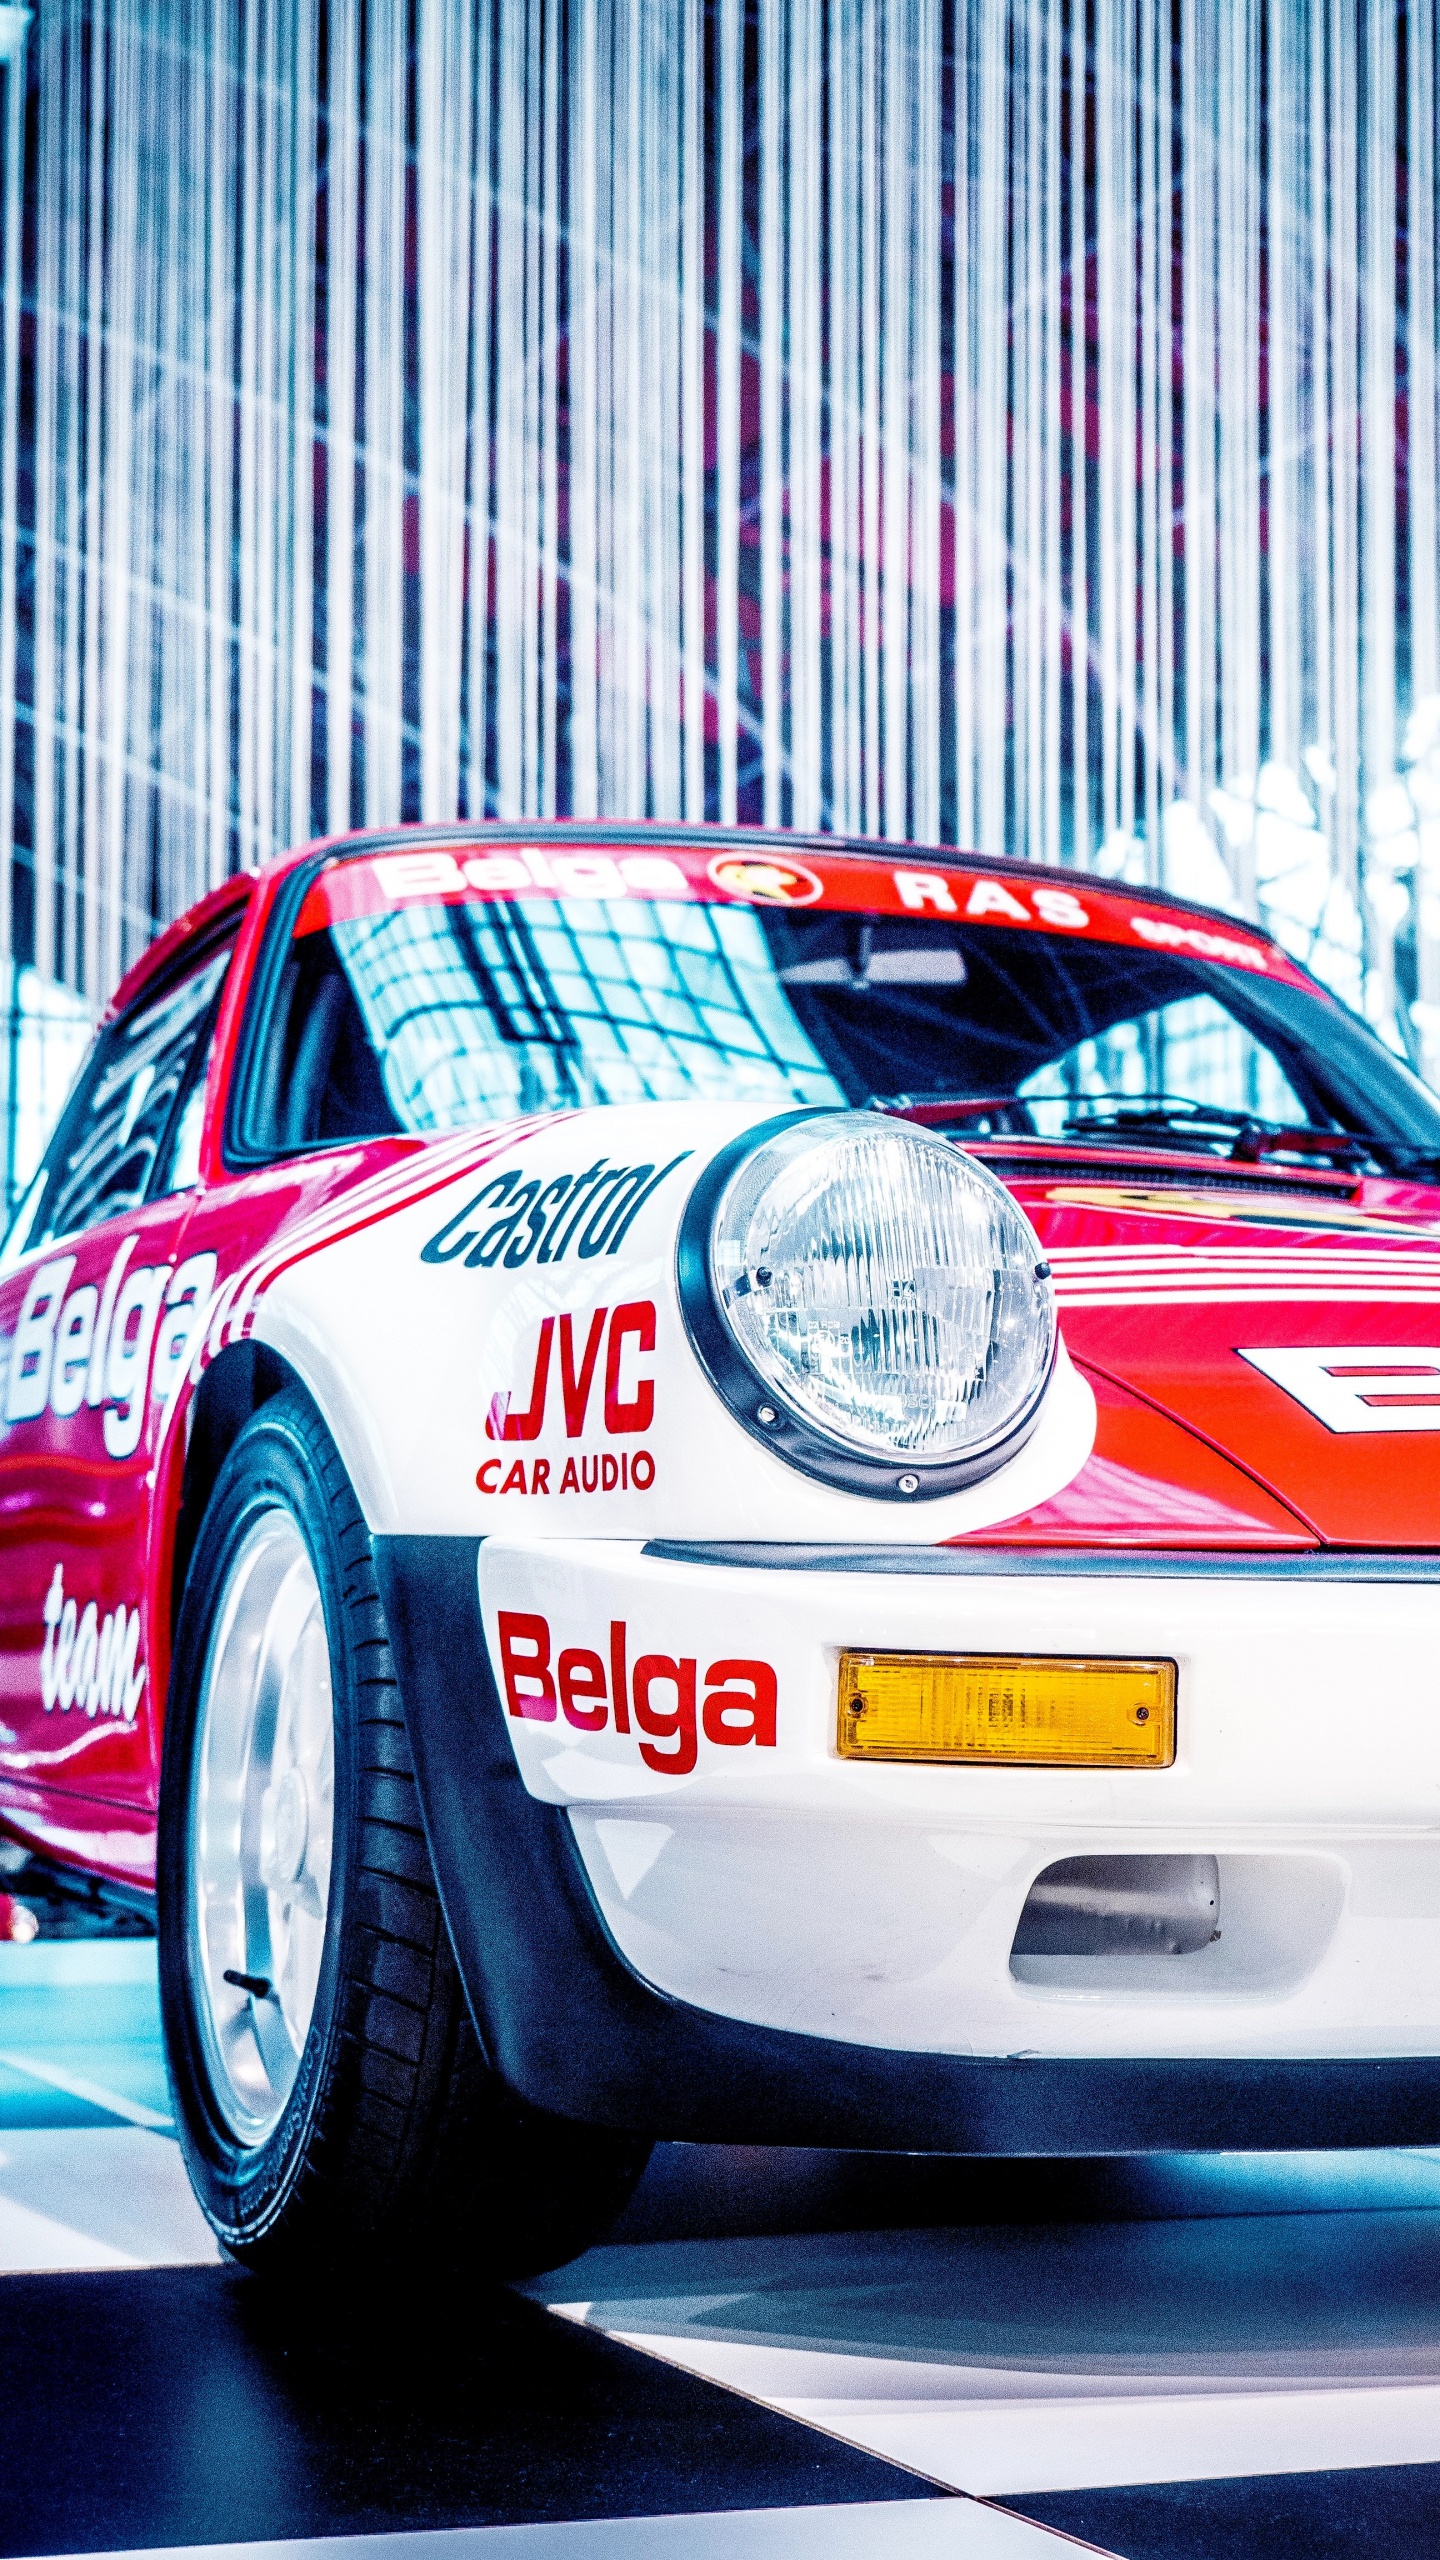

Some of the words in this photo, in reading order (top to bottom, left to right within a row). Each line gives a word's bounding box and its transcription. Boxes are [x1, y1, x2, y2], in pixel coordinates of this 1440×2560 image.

[371, 847, 690, 899] Belga
[893, 870, 1090, 929] RAS
[420, 1150, 696, 1269] Castrol
[5, 1234, 219, 1461] Belga
[484, 1300, 657, 1441] JVC
[475, 1458, 551, 1495] CAR
[559, 1450, 656, 1495] AUDIO
[497, 1610, 778, 1775] Belga
